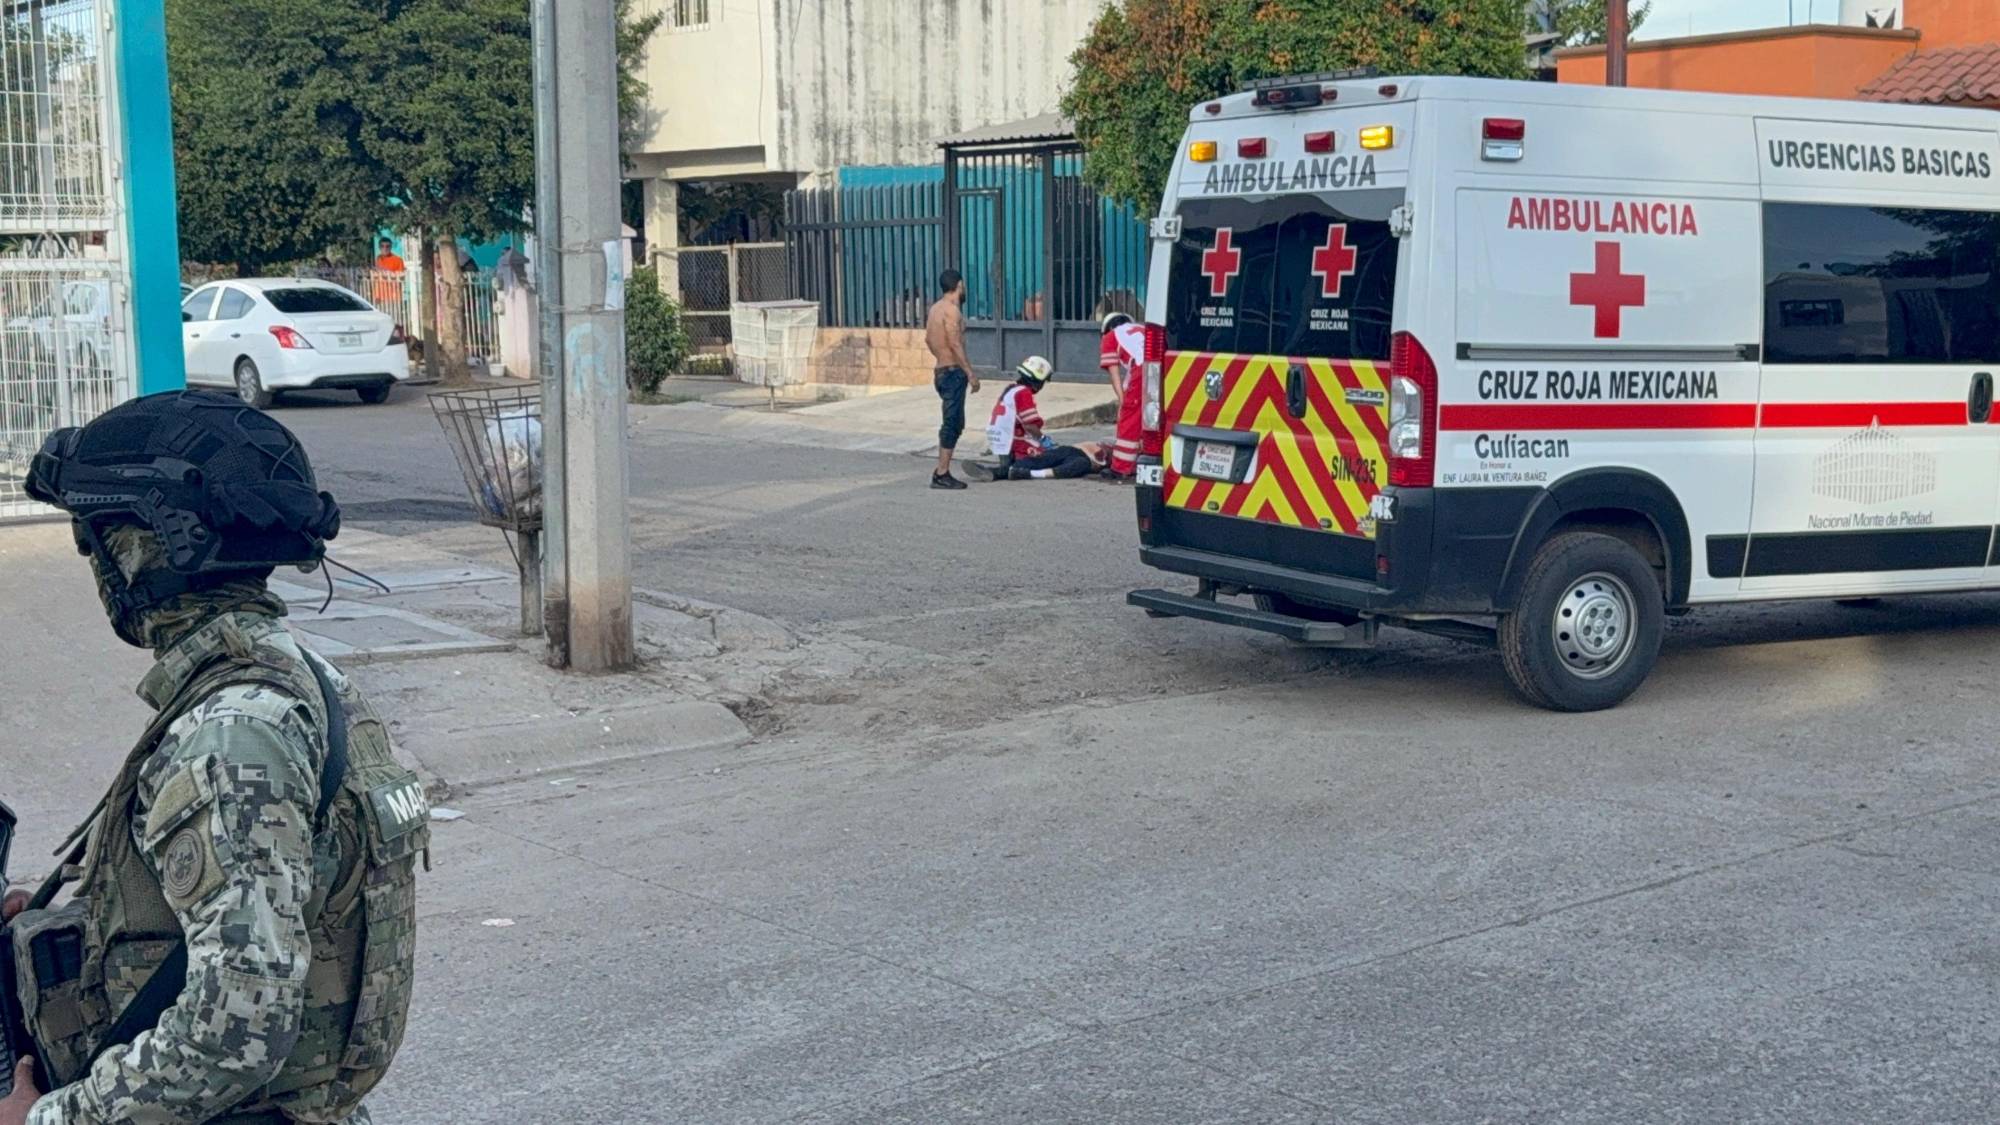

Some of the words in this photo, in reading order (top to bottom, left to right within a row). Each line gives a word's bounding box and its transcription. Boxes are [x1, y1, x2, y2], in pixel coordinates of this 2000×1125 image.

[1768, 139, 1896, 173] URGENCIAS
[1902, 147, 1991, 178] BASICAS
[1203, 154, 1377, 194] AMBULANCIA
[1507, 197, 1698, 236] AMBULANCIA
[1200, 307, 1216, 316] CRUZ
[1218, 307, 1234, 316] ROJA
[1310, 309, 1329, 318] CRUZ
[1331, 309, 1349, 319] ROJA
[1200, 318, 1234, 327] MEXICANA
[1310, 321, 1348, 330] MEXICANA
[1478, 370, 1539, 400] CRUZ
[1545, 370, 1602, 400] ROJA
[1609, 370, 1719, 399] MEXICANA
[1474, 433, 1569, 459] Culiacan
[1331, 455, 1377, 484] SIN-235
[1459, 473, 1482, 483] LAURA
[1492, 471, 1522, 482] VENTURA
[1808, 513, 1852, 529] Nacional
[1853, 512, 1884, 527] Monte
[1886, 512, 1898, 526] de
